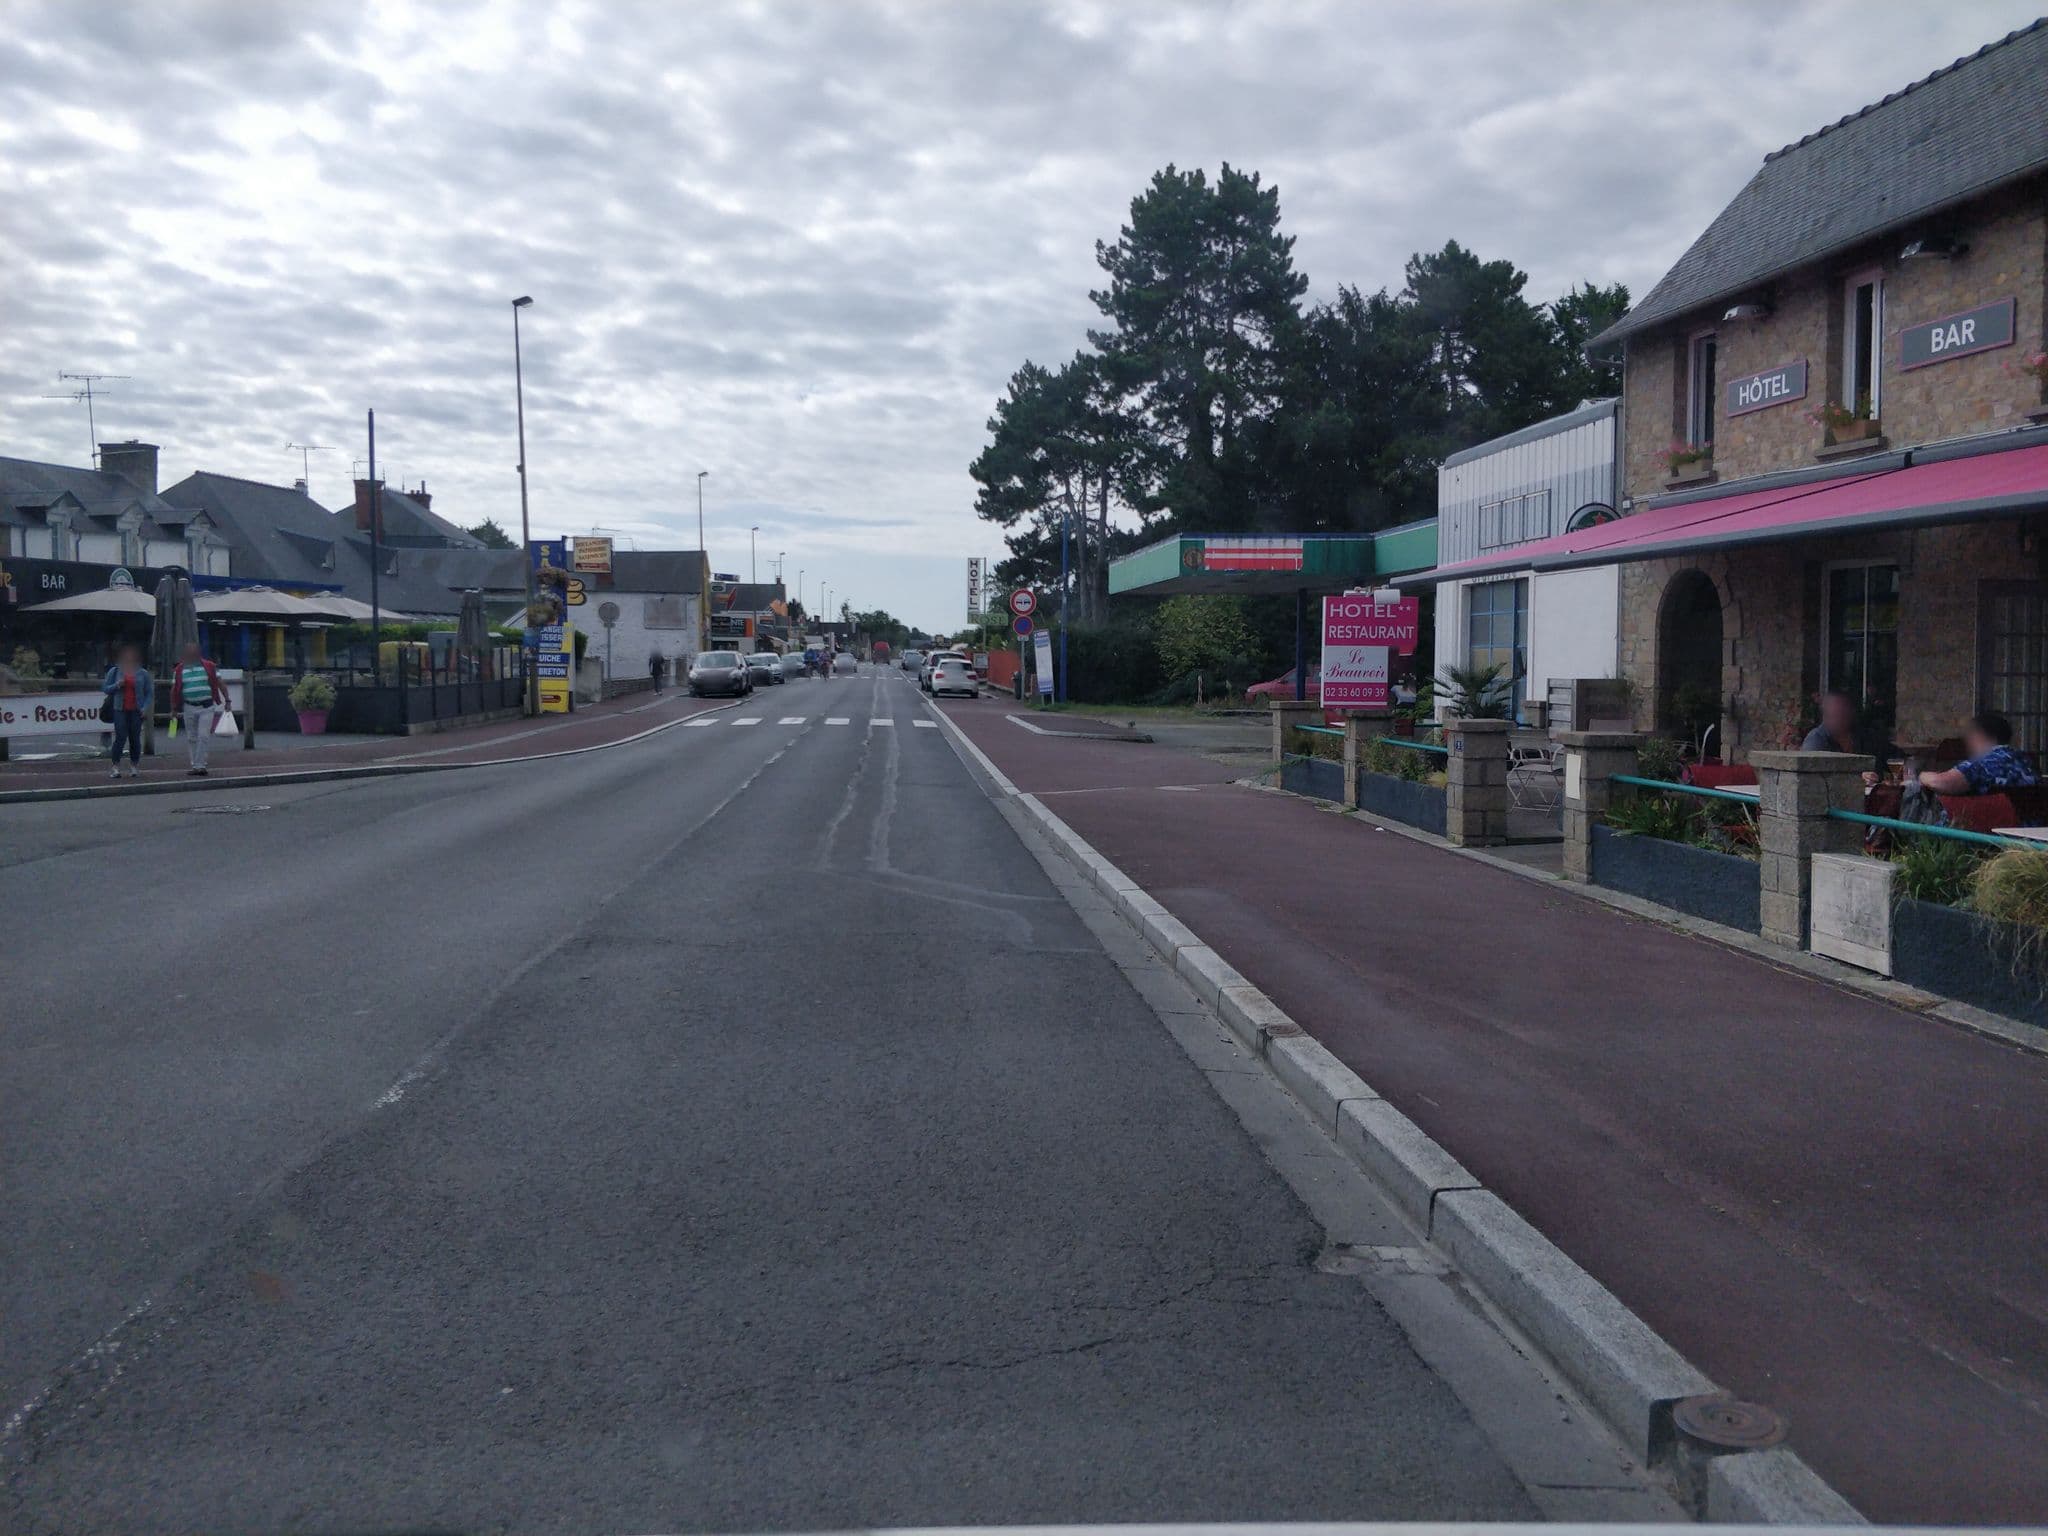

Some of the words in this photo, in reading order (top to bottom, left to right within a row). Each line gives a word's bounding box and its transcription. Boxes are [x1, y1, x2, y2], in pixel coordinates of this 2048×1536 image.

[1930, 318, 1976, 353] BAR
[1738, 373, 1791, 406] HÔTEL
[42, 574, 65, 590] BAR
[970, 561, 978, 605] HOTEL
[1329, 604, 1397, 618] HOTEL
[1328, 625, 1415, 639] RESTAURANT
[1349, 648, 1366, 664] Le
[1325, 687, 1336, 697] 02
[1337, 687, 1348, 697] 33
[1350, 687, 1361, 697] 60
[1362, 687, 1373, 697] 09
[1374, 687, 1385, 697] 39
